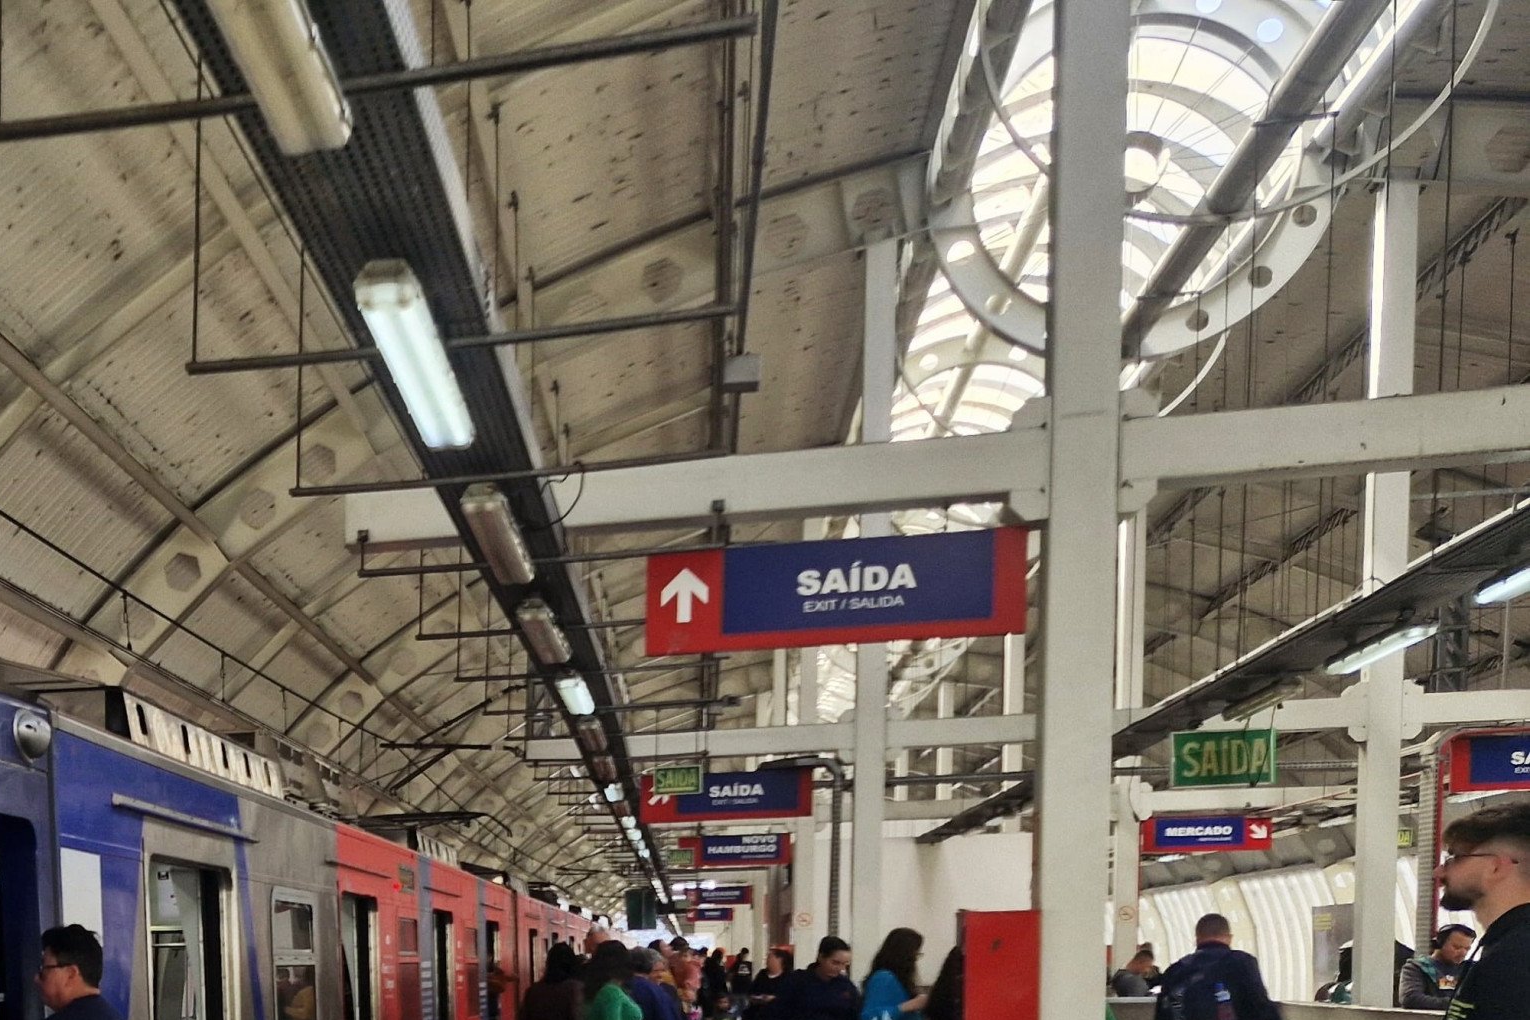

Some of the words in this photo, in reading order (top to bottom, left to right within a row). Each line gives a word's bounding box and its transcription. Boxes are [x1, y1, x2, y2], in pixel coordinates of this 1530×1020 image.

[796, 560, 917, 596] SAÍDA
[802, 600, 838, 613] EXIT
[849, 595, 905, 610] SALIDA
[709, 782, 765, 797] SAÍDA
[1164, 825, 1233, 837] MERCADO
[741, 835, 777, 844] NOVO
[707, 845, 777, 855] HAMBURGO
